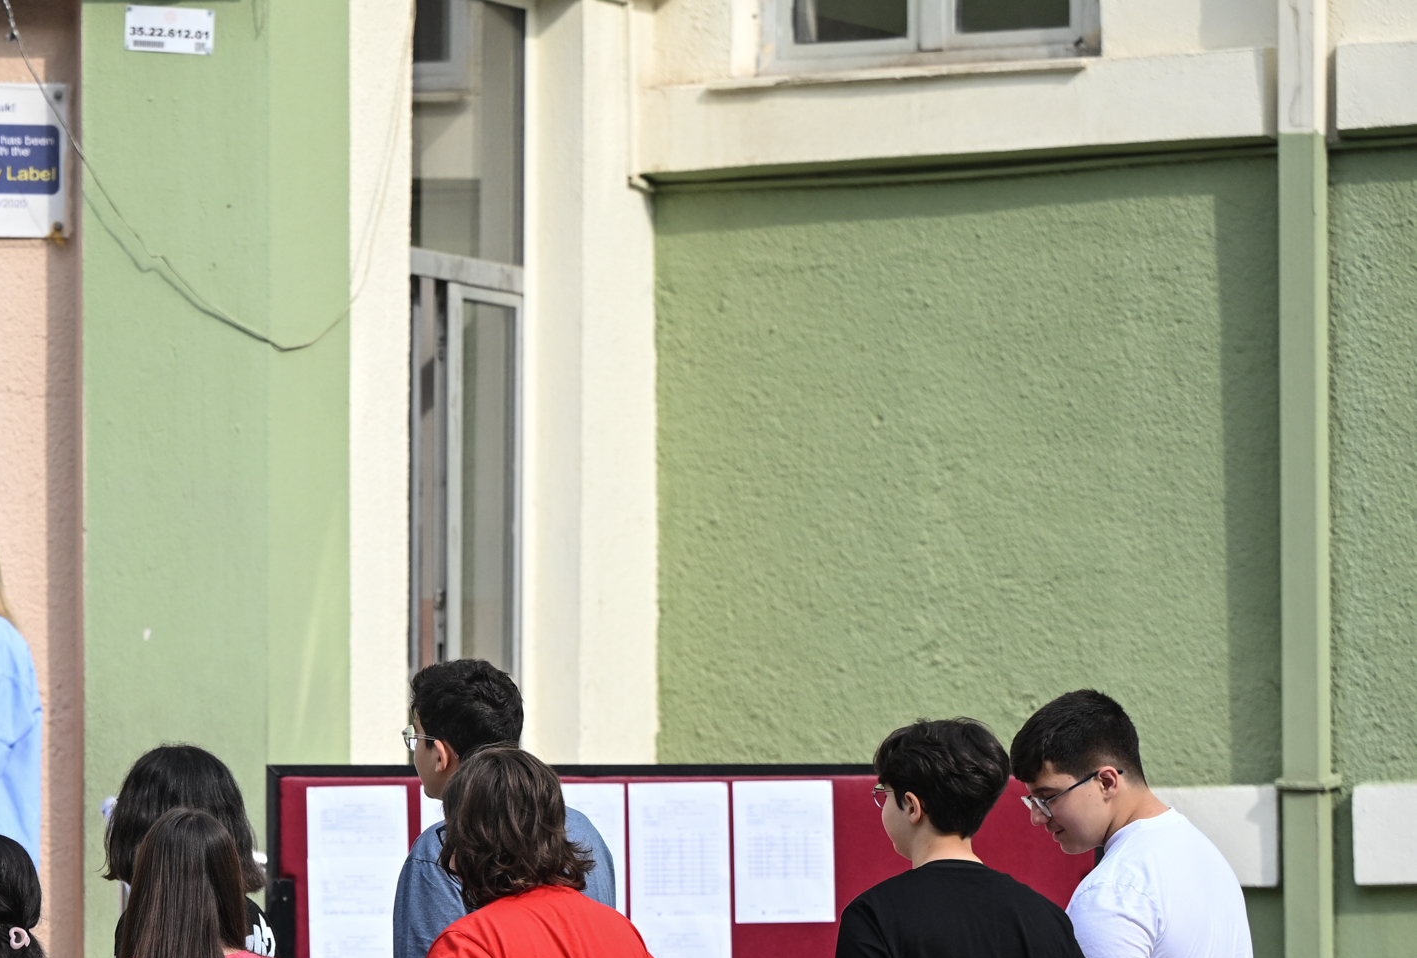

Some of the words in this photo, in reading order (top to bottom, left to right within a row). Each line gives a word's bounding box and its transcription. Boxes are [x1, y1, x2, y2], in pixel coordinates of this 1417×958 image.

[129, 26, 210, 40] 35.22.612.01
[0, 135, 22, 146] has
[24, 135, 55, 146] been
[10, 146, 31, 157] the
[6, 166, 56, 182] Label
